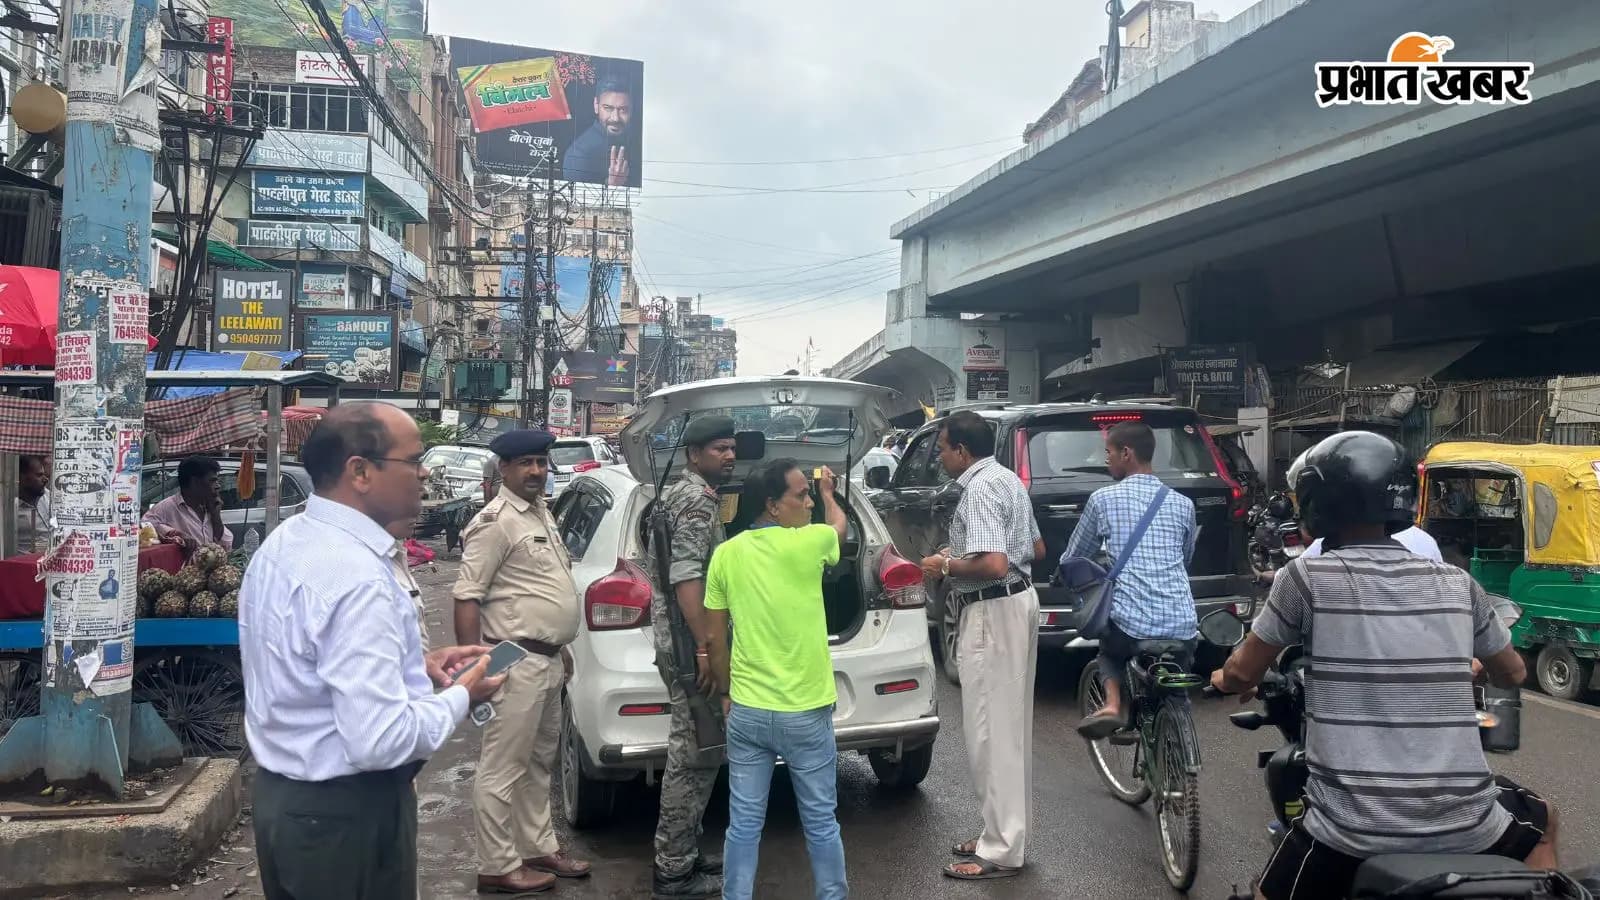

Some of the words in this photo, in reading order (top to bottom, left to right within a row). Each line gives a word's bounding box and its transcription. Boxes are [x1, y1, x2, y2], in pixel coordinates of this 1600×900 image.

[71, 40, 122, 66] ARMY
[299, 54, 331, 72] होटल
[222, 277, 283, 300] HOTEL
[241, 301, 264, 315] THE
[220, 315, 283, 330] LEELAWATI
[337, 320, 389, 334] BANQUET
[230, 333, 283, 345] 9504977777
[1203, 374, 1209, 382] &
[1211, 372, 1233, 383] BATH
